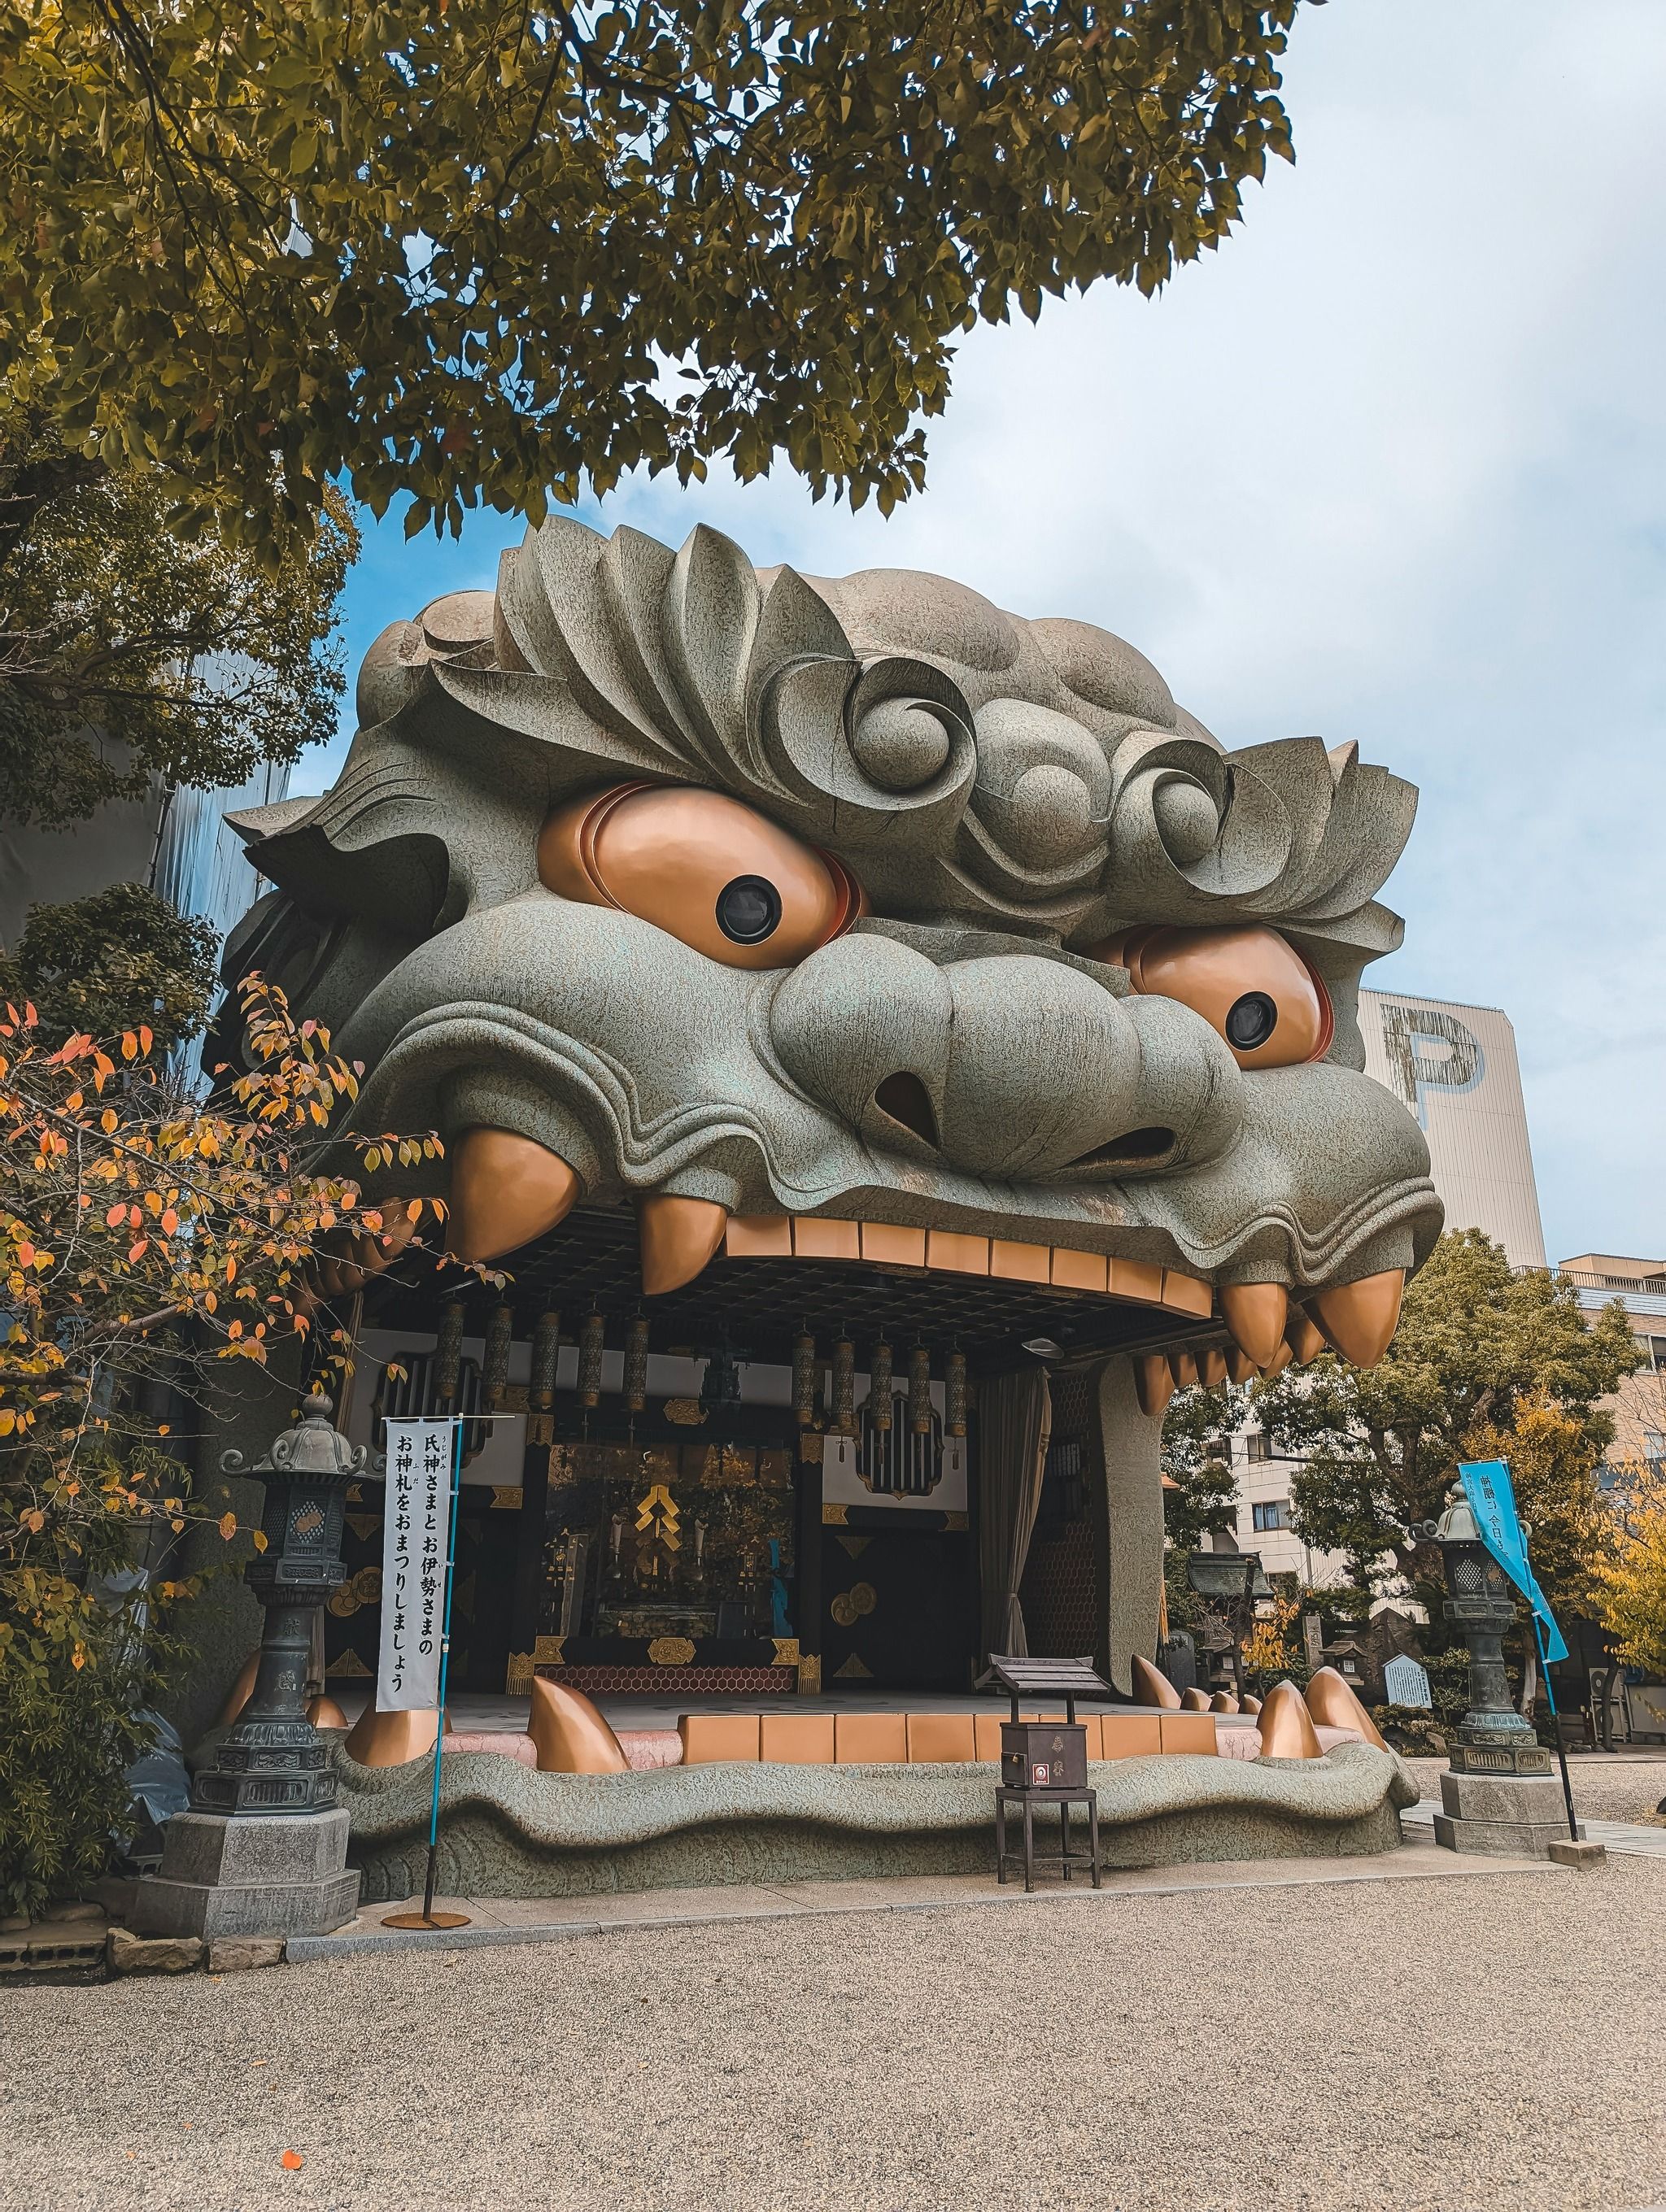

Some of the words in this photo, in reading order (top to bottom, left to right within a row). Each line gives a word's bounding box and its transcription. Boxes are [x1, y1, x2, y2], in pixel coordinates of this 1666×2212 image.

[1380, 1004, 1479, 1121] P
[391, 1435, 413, 1693] お神札をおまつりしましょう
[418, 1433, 440, 1656] 氏神さまとお伊勢さまの
